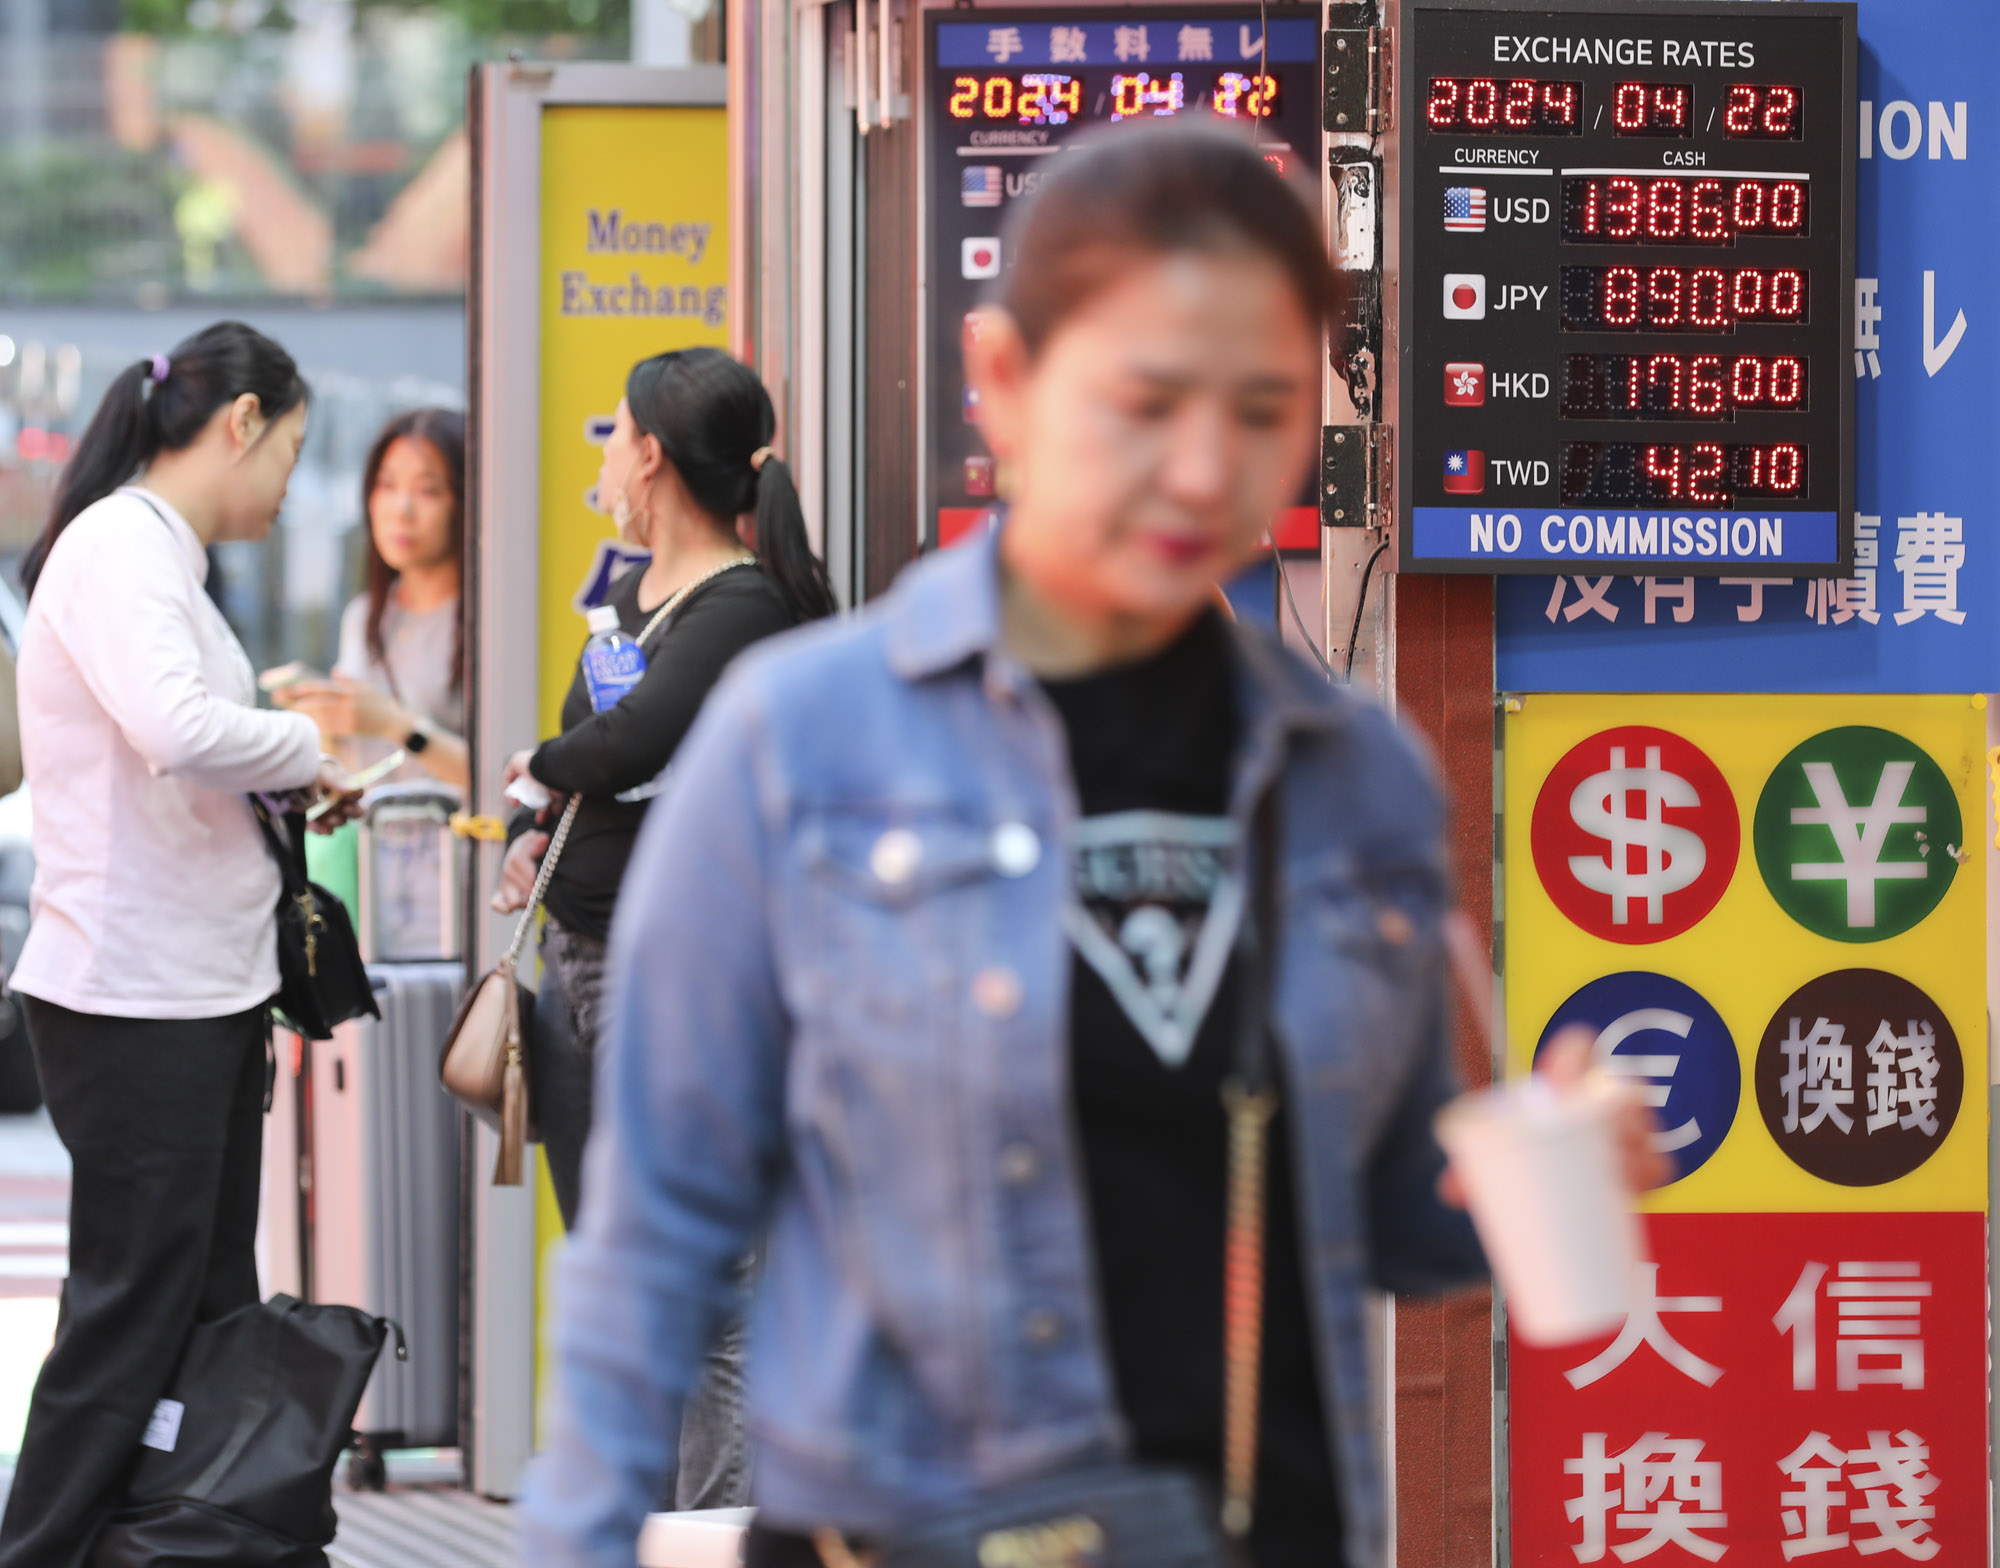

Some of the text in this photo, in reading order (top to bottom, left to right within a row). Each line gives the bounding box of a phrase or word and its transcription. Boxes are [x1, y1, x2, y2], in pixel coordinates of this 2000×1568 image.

[1494, 35, 1756, 69] EXCHANGE RATES
[949, 74, 1080, 118] 2024
[1114, 76, 1182, 118] 04
[1428, 79, 1573, 126] 2024
[1615, 84, 1683, 128] 04
[1726, 87, 1793, 131] 22
[1454, 148, 1540, 165] CURRENCY
[1662, 151, 1706, 167] CASH
[1005, 172, 1054, 198] US
[1493, 197, 1550, 224] USD
[586, 208, 711, 264] Money
[1493, 285, 1549, 312] JPY
[1491, 371, 1550, 400] HKD
[1491, 460, 1550, 487] TWD
[1471, 514, 1783, 556] NO COMMISSION
[1779, 1016, 1942, 1137] 換錢
[1562, 1260, 1933, 1391] 大信
[1563, 1429, 1943, 1565] 換錢
